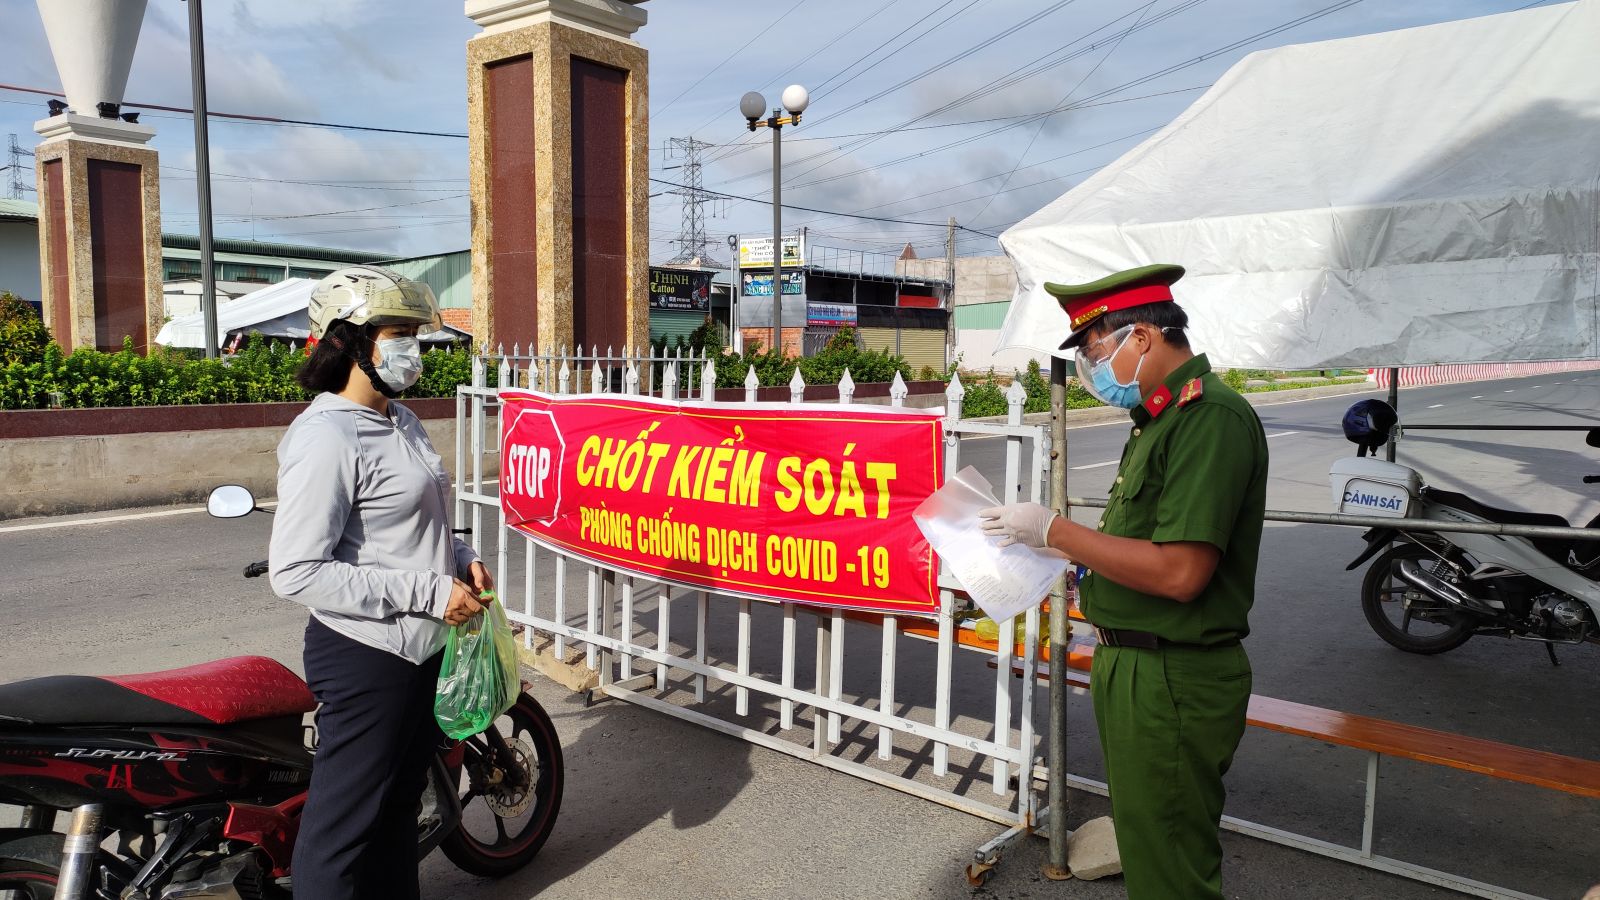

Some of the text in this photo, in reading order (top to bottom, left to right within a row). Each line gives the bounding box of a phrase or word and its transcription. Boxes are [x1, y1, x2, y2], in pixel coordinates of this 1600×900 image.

[506, 444, 551, 499] STOP
[576, 420, 897, 519] CHỐT KIỂM SOÁT
[1343, 489, 1402, 511] CẢNH SÁT
[579, 501, 890, 589] PHÒNG CHỐNG DỊCH COVID -19
[268, 770, 300, 783] YAMAHA
